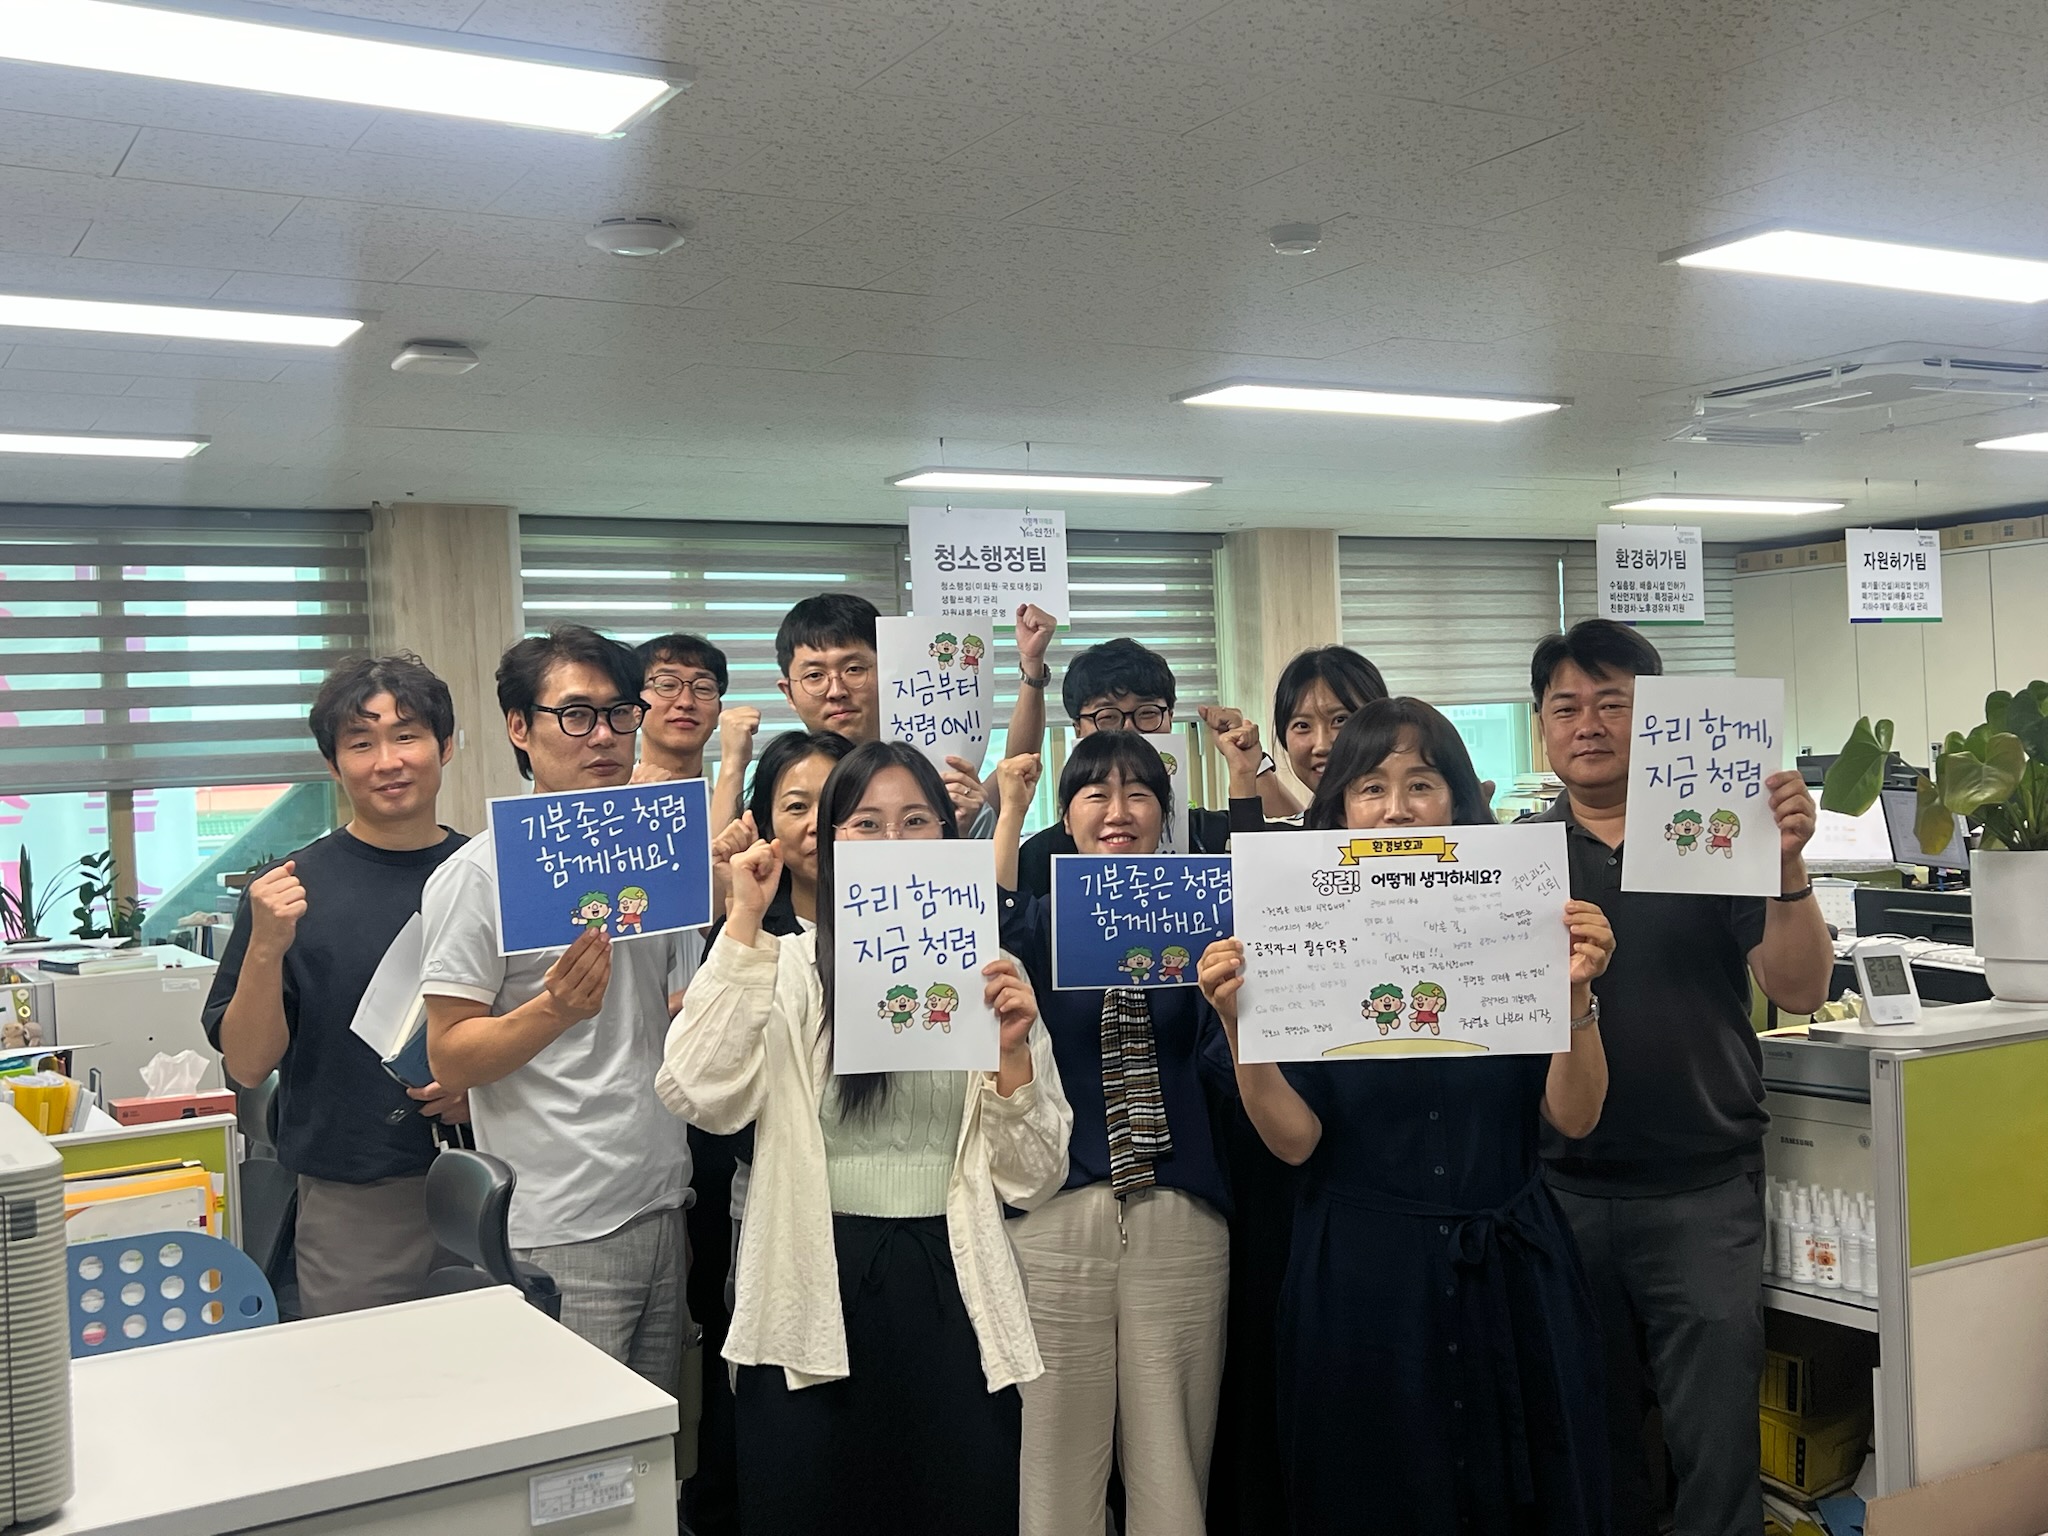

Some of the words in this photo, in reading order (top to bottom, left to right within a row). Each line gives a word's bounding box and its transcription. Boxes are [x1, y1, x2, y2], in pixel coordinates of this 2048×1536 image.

[934, 544, 1046, 572] 청소행정팀
[1615, 548, 1686, 570] 환경허가팀
[1863, 551, 1926, 571] 자원허가팀
[1639, 580, 1666, 591] 배출시설
[1667, 581, 1686, 591] 인허가
[1912, 581, 1930, 590] 인허가
[1913, 592, 1924, 601] 신고
[941, 595, 981, 605] 생활쓰레기
[983, 595, 998, 605] 관리
[1609, 592, 1649, 602] 비산먼지발생
[1654, 592, 1680, 602] 특정공사
[1681, 593, 1694, 602] 신고
[1610, 603, 1671, 613] 친환경차·노후경유차
[1672, 604, 1685, 613] 지원
[1916, 602, 1928, 611] 관리
[991, 608, 1006, 617] 운영
[892, 670, 979, 707] 지금부터
[891, 713, 936, 746] 청렴
[941, 710, 982, 743] ON!!
[1638, 715, 1690, 746] 우리
[1698, 708, 1772, 751] 함께,
[1645, 755, 1698, 799] 지금
[1706, 757, 1761, 799] 청렴
[631, 794, 687, 834] 청렴
[1371, 839, 1423, 852] 환경보호과
[536, 833, 680, 889] 함께해요!
[1180, 866, 1232, 905] 청렴
[1311, 869, 1361, 896] 청렴!
[1371, 871, 1416, 890] 어떻게
[1419, 868, 1502, 889] 생각하세요?
[1511, 860, 1551, 892] 주민과의
[1537, 875, 1561, 897] 신뢰
[843, 883, 898, 917] 우리
[906, 874, 986, 919] 함께,
[1090, 902, 1223, 941] 함께해요!
[853, 926, 910, 974] 지금
[918, 927, 977, 970] 청렴
[1480, 995, 1509, 1008] 공직자의
[1495, 1010, 1524, 1027] 나부터
[1529, 1008, 1552, 1025] 시작
[1780, 1136, 1814, 1147] SAMSUNG
[637, 1463, 648, 1474] 12
